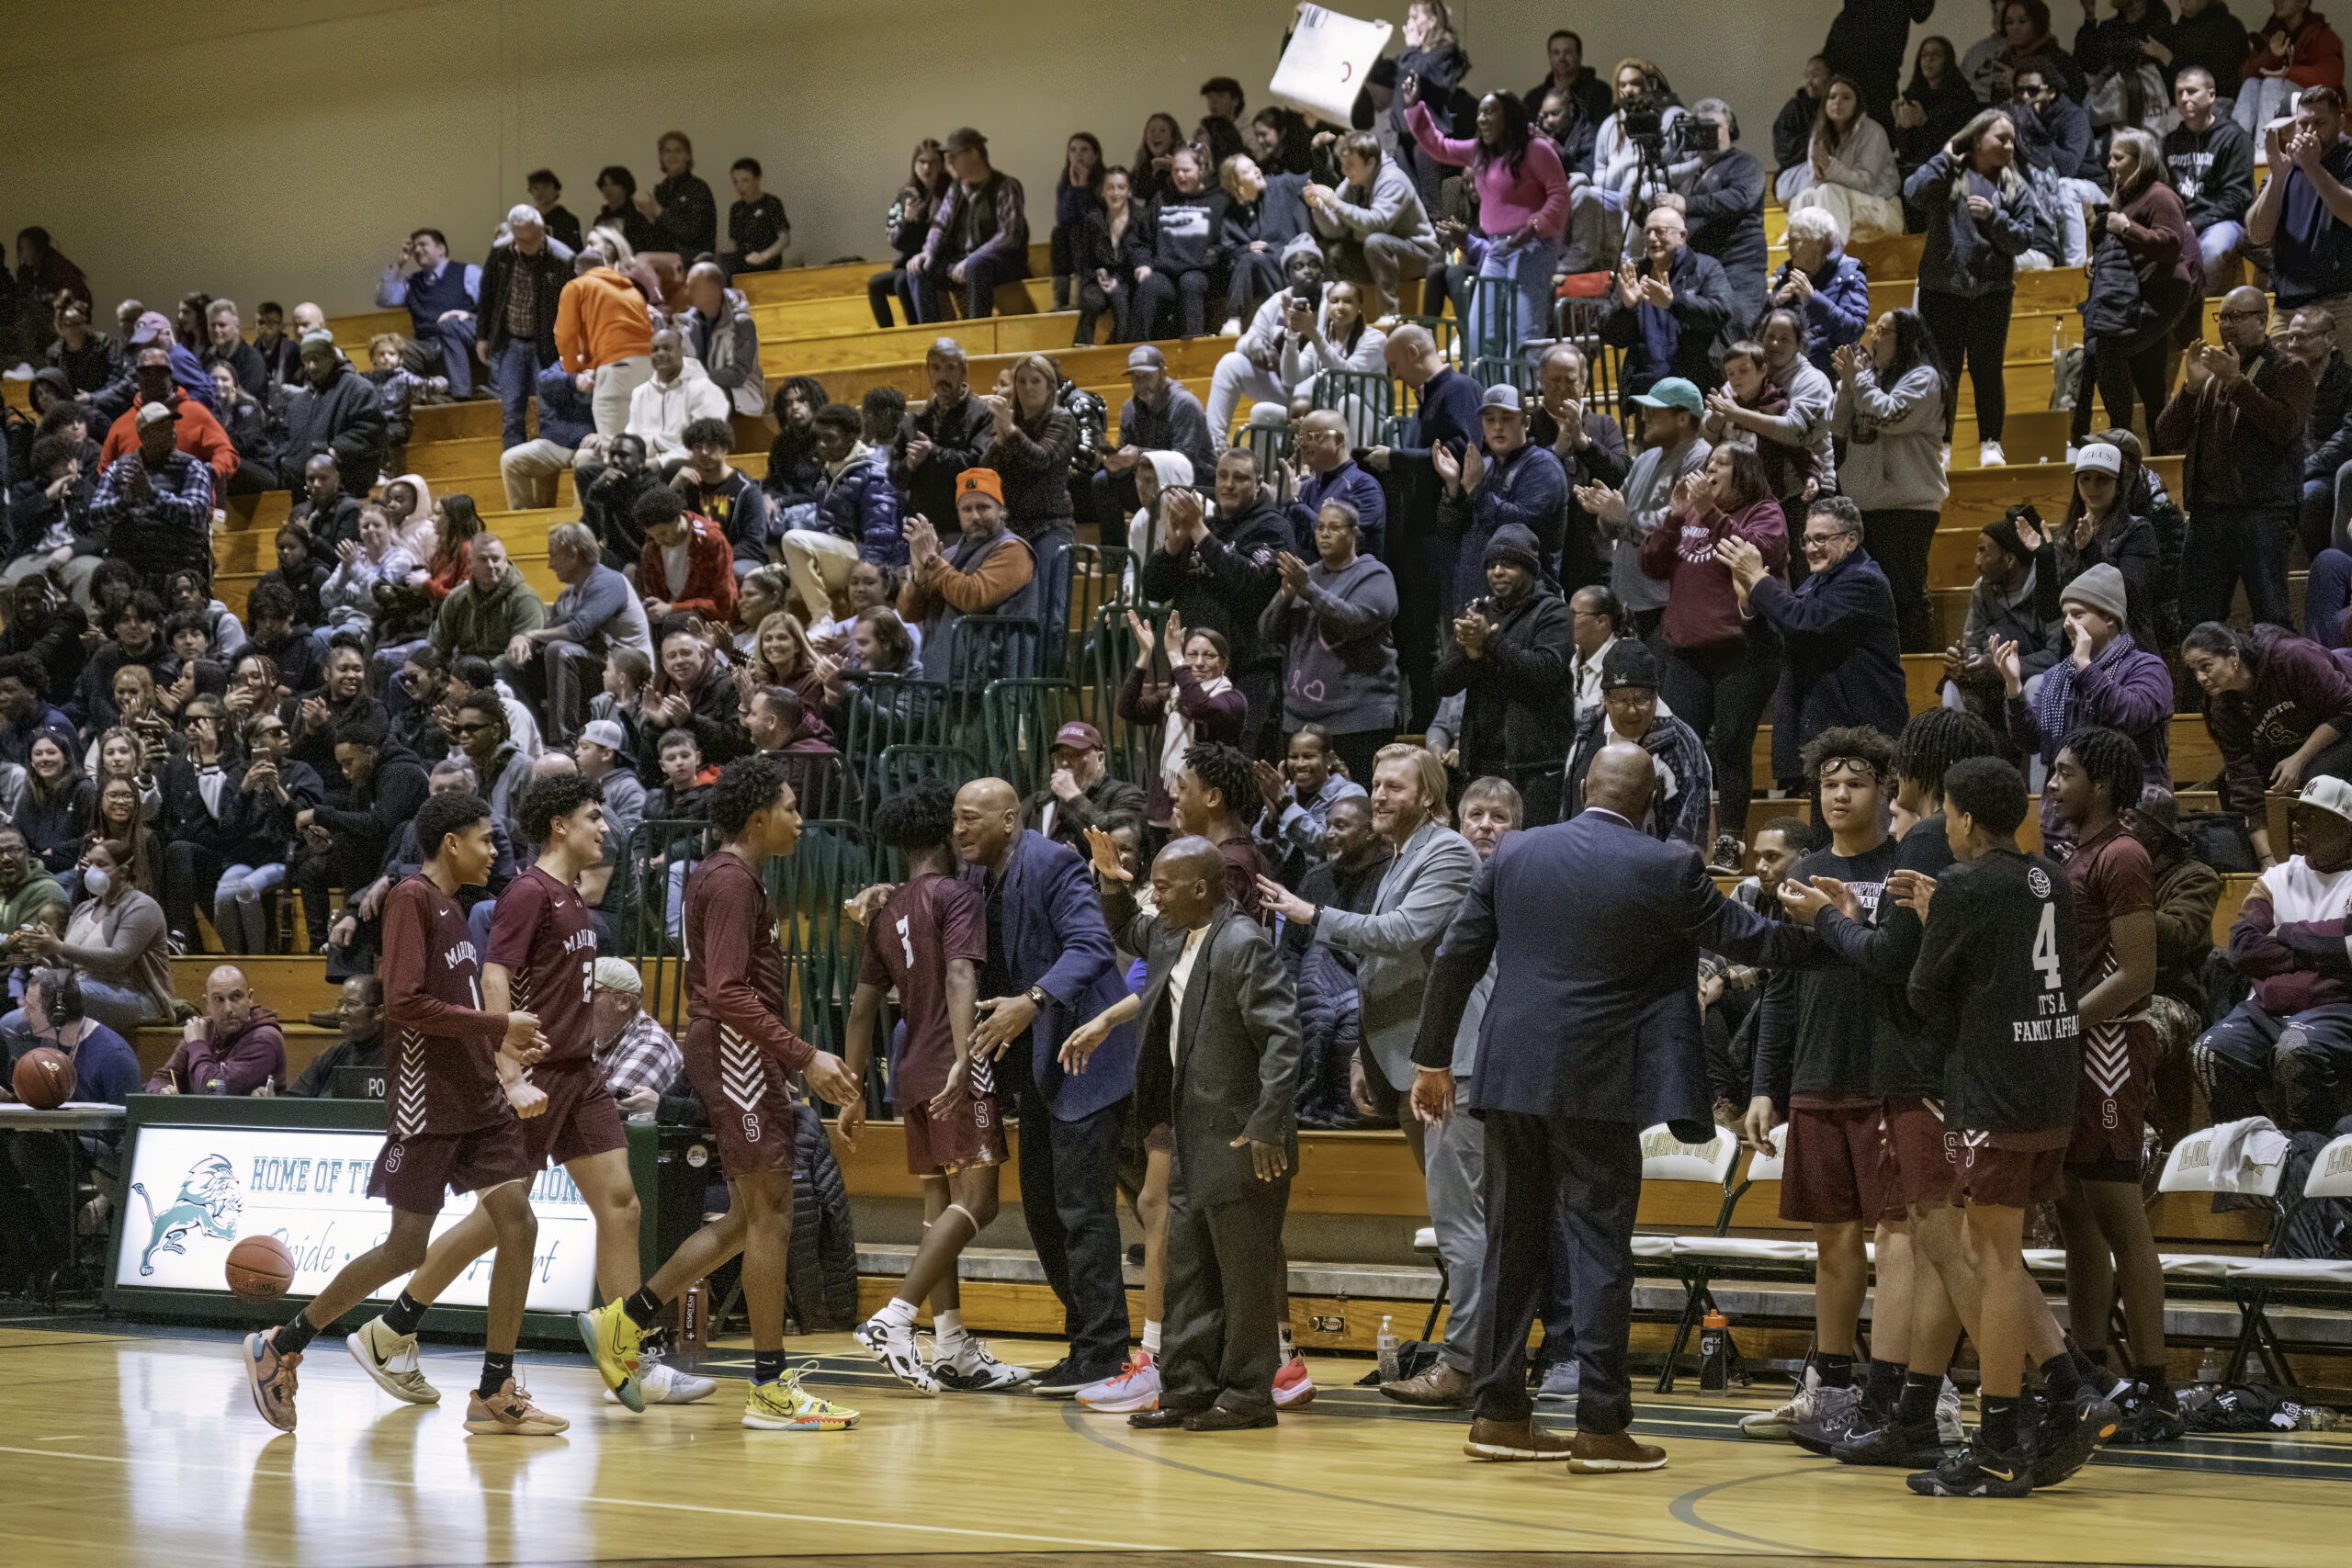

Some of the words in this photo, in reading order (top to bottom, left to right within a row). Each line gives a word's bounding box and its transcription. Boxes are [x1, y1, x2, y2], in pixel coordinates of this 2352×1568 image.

[2084, 451, 2113, 461] ZEUS
[2032, 902, 2061, 989] 4
[469, 975, 481, 1011] 1
[2038, 994, 2055, 1015] IT'S
[2059, 992, 2067, 1012] A
[742, 1113, 760, 1142] S
[974, 1101, 989, 1128] S
[2102, 1099, 2118, 1128] S
[385, 1143, 404, 1173] S
[250, 1157, 311, 1193] HOME
[314, 1158, 344, 1194] OF
[348, 1159, 375, 1195] TH
[685, 1295, 695, 1329] essentia
